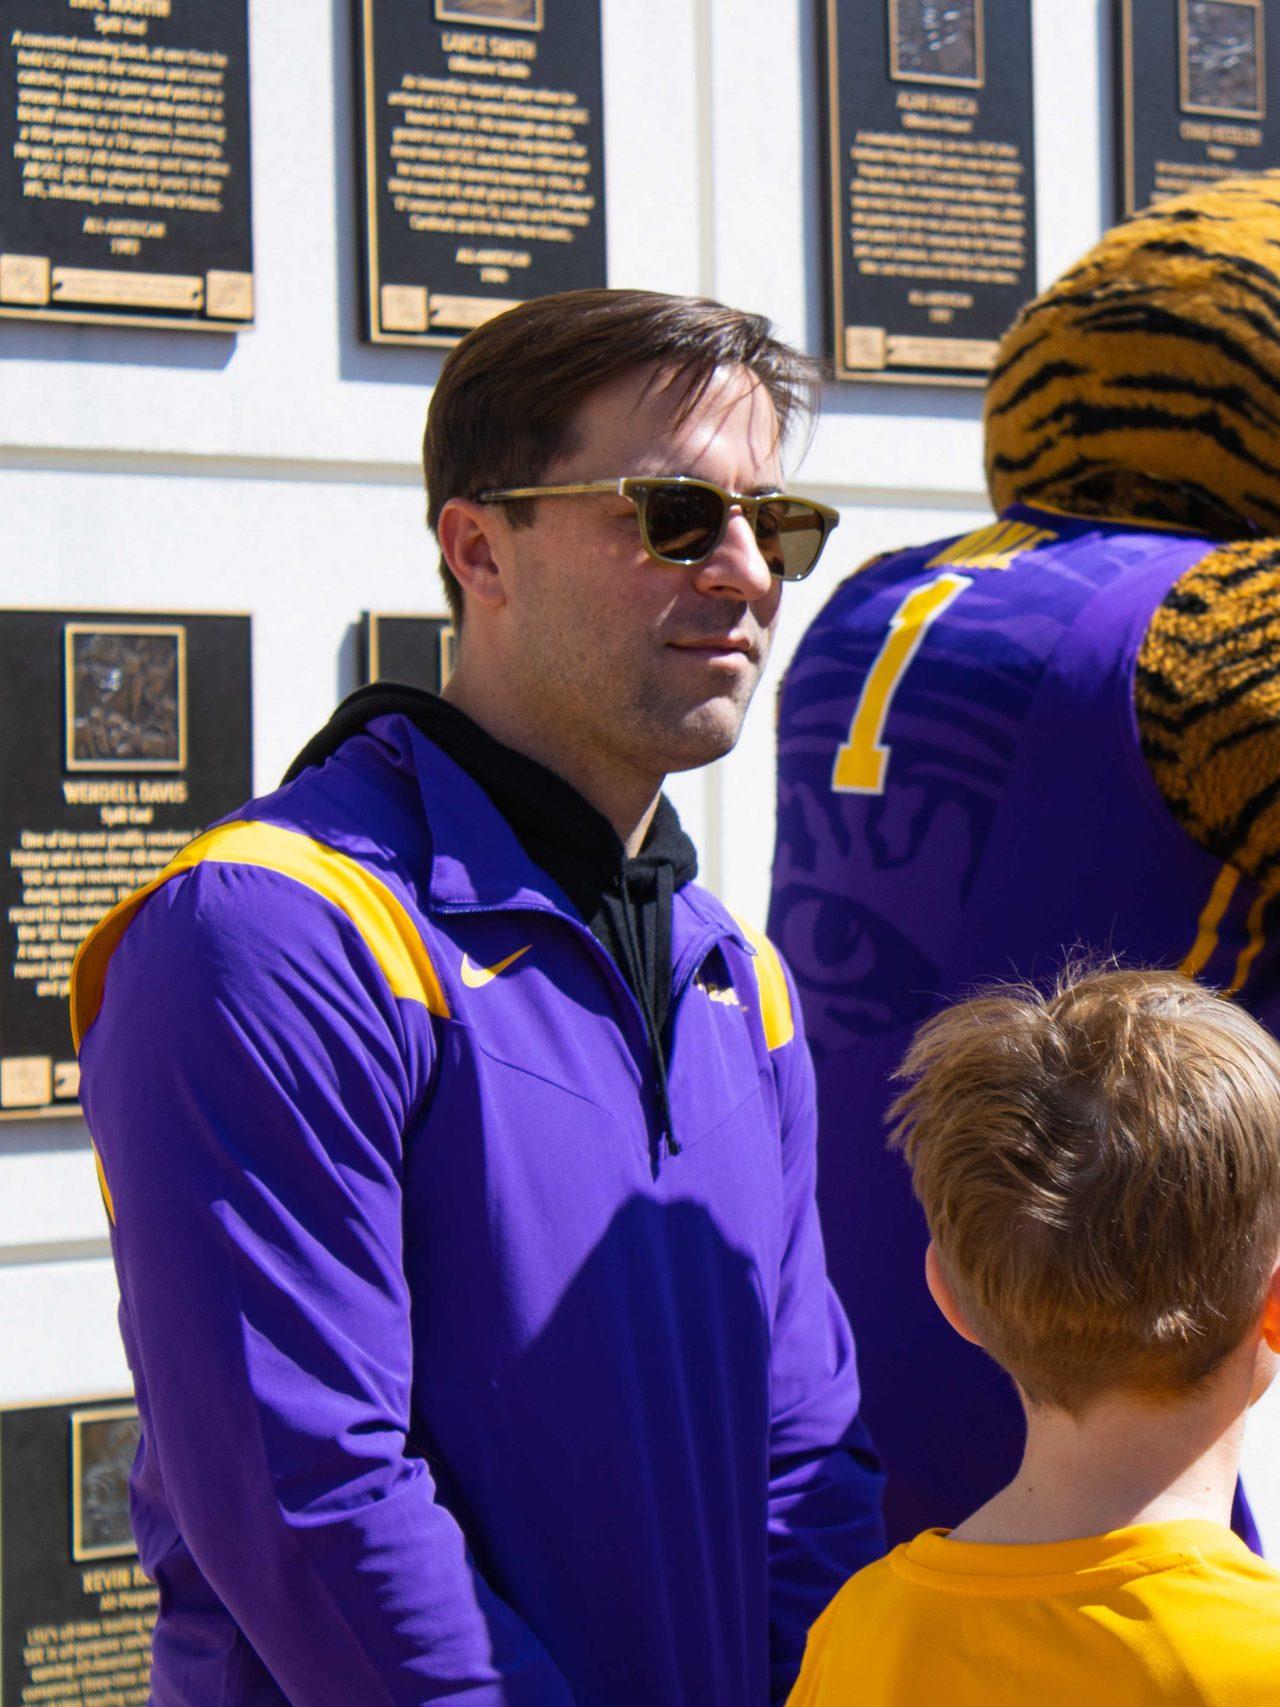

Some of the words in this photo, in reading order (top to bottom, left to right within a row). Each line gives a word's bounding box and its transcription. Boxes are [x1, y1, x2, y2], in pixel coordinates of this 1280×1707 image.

[441, 31, 488, 55] LANCE
[489, 34, 537, 60] SMITH
[832, 572, 975, 796] 1
[63, 780, 138, 805] WENDELL
[139, 780, 189, 805] DAVIS
[101, 806, 128, 827] Split
[129, 806, 154, 825] End
[83, 1568, 131, 1594] KEVIN
